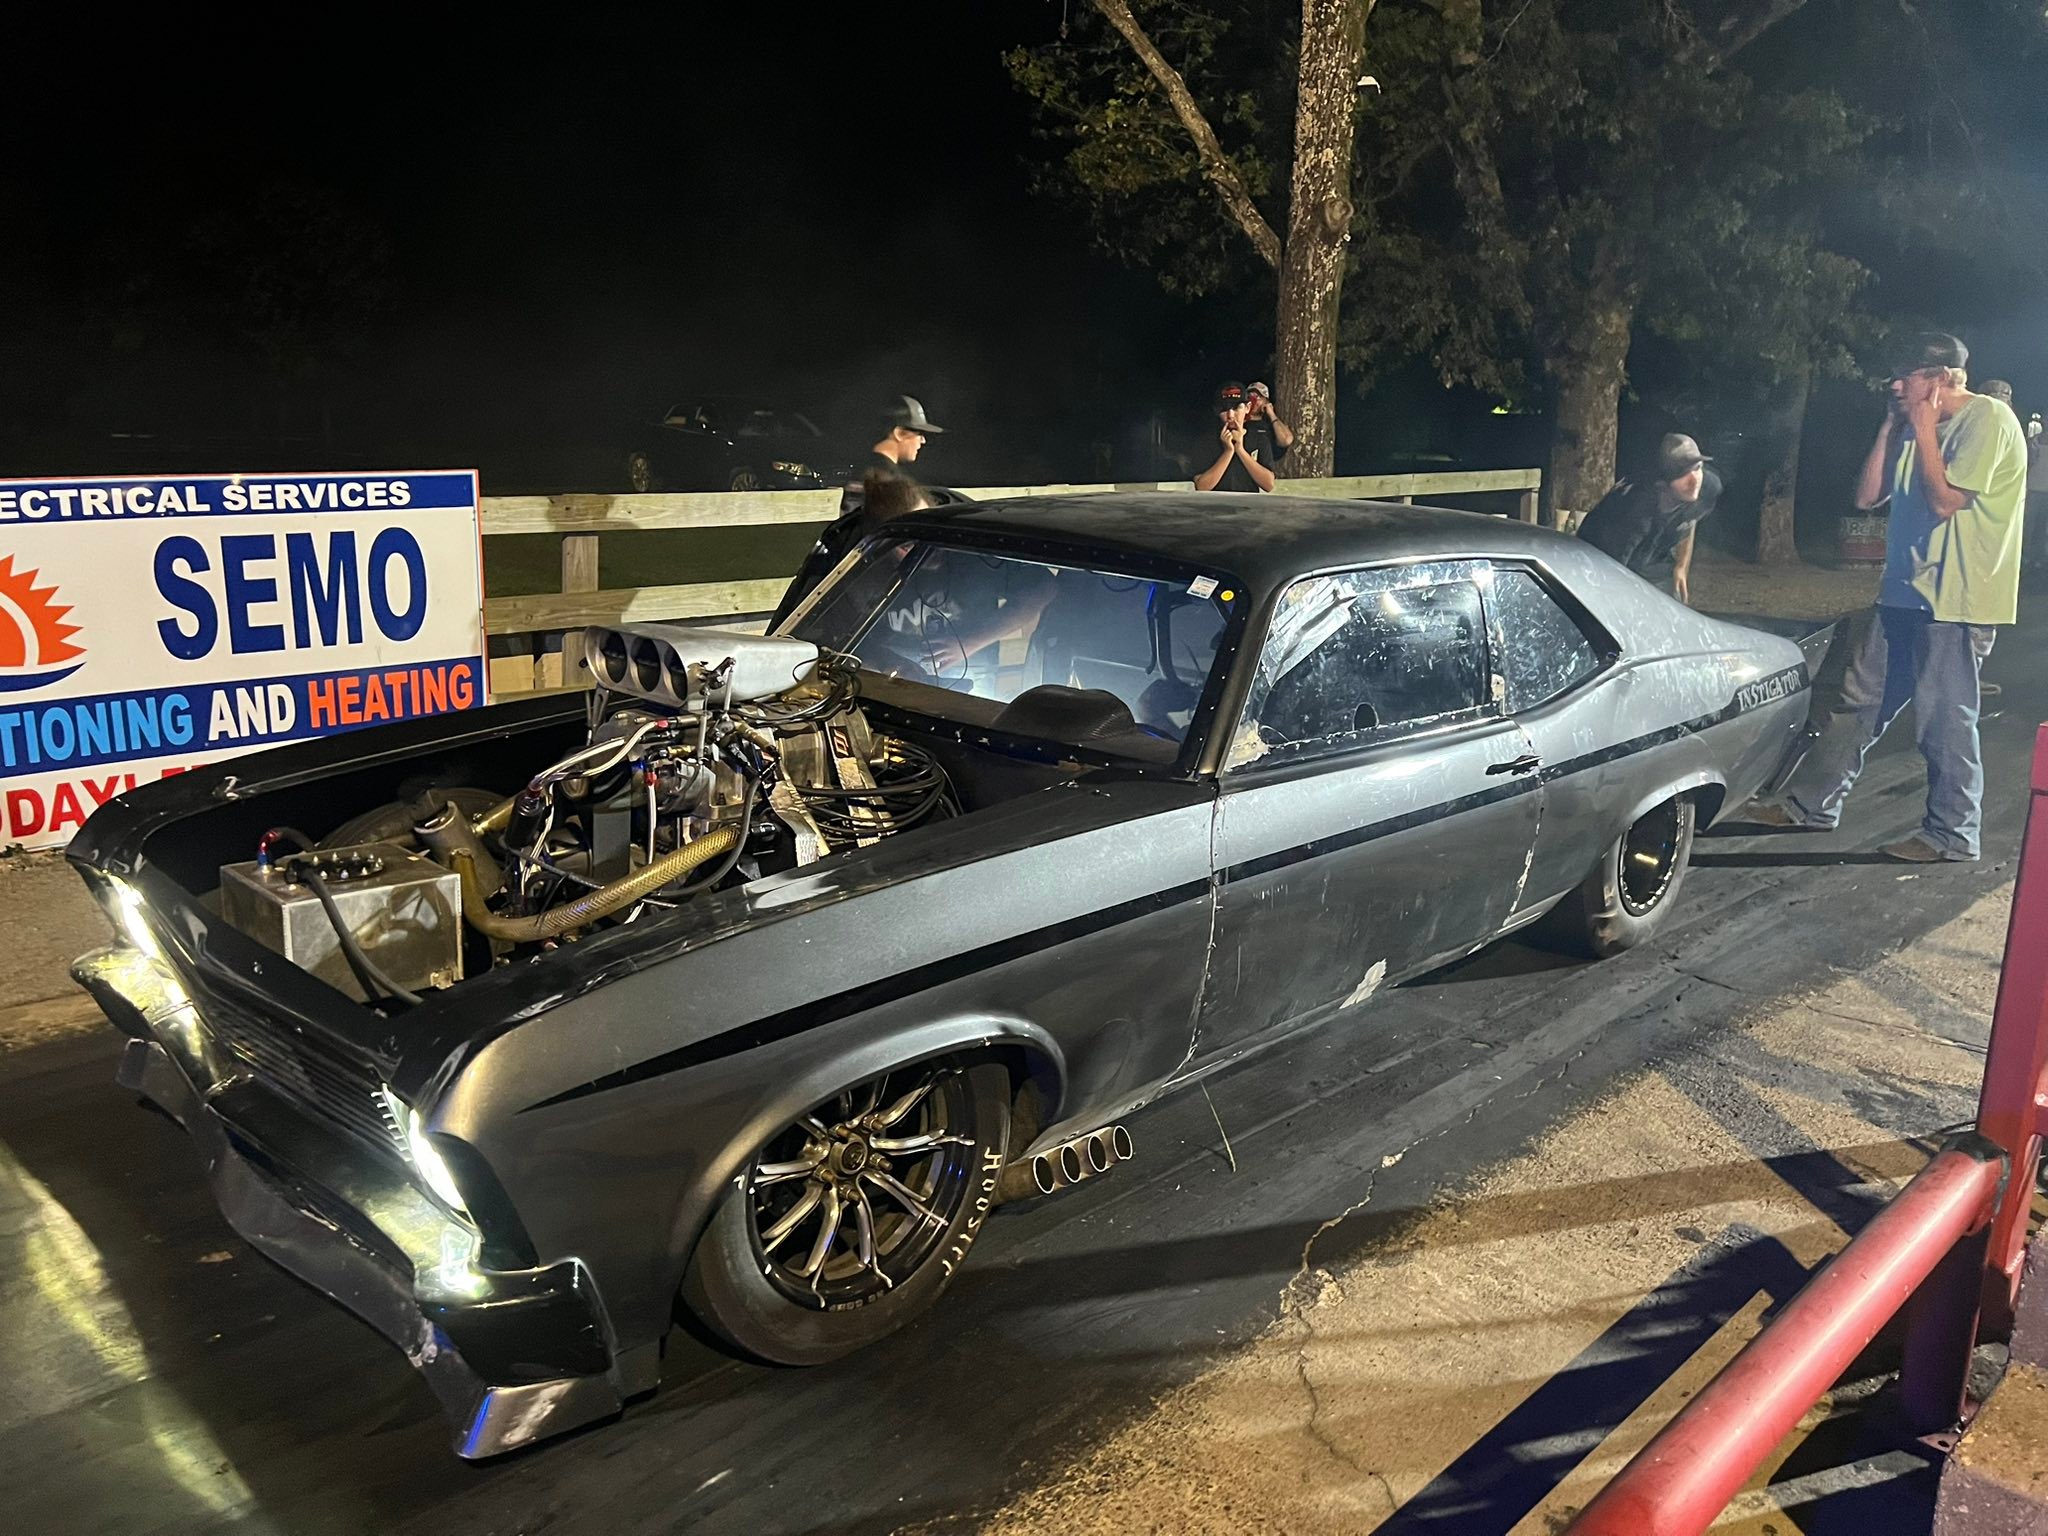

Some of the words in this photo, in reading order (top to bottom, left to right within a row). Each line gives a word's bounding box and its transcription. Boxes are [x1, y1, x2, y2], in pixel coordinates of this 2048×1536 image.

[0, 486, 210, 518] ECTRICAL
[222, 481, 411, 511] SERVICES
[154, 527, 427, 660] SEMO
[0, 694, 193, 767] TIONING
[208, 684, 296, 741] AND
[308, 664, 474, 728] HEATING
[1737, 670, 1802, 712] INSTIGATOR
